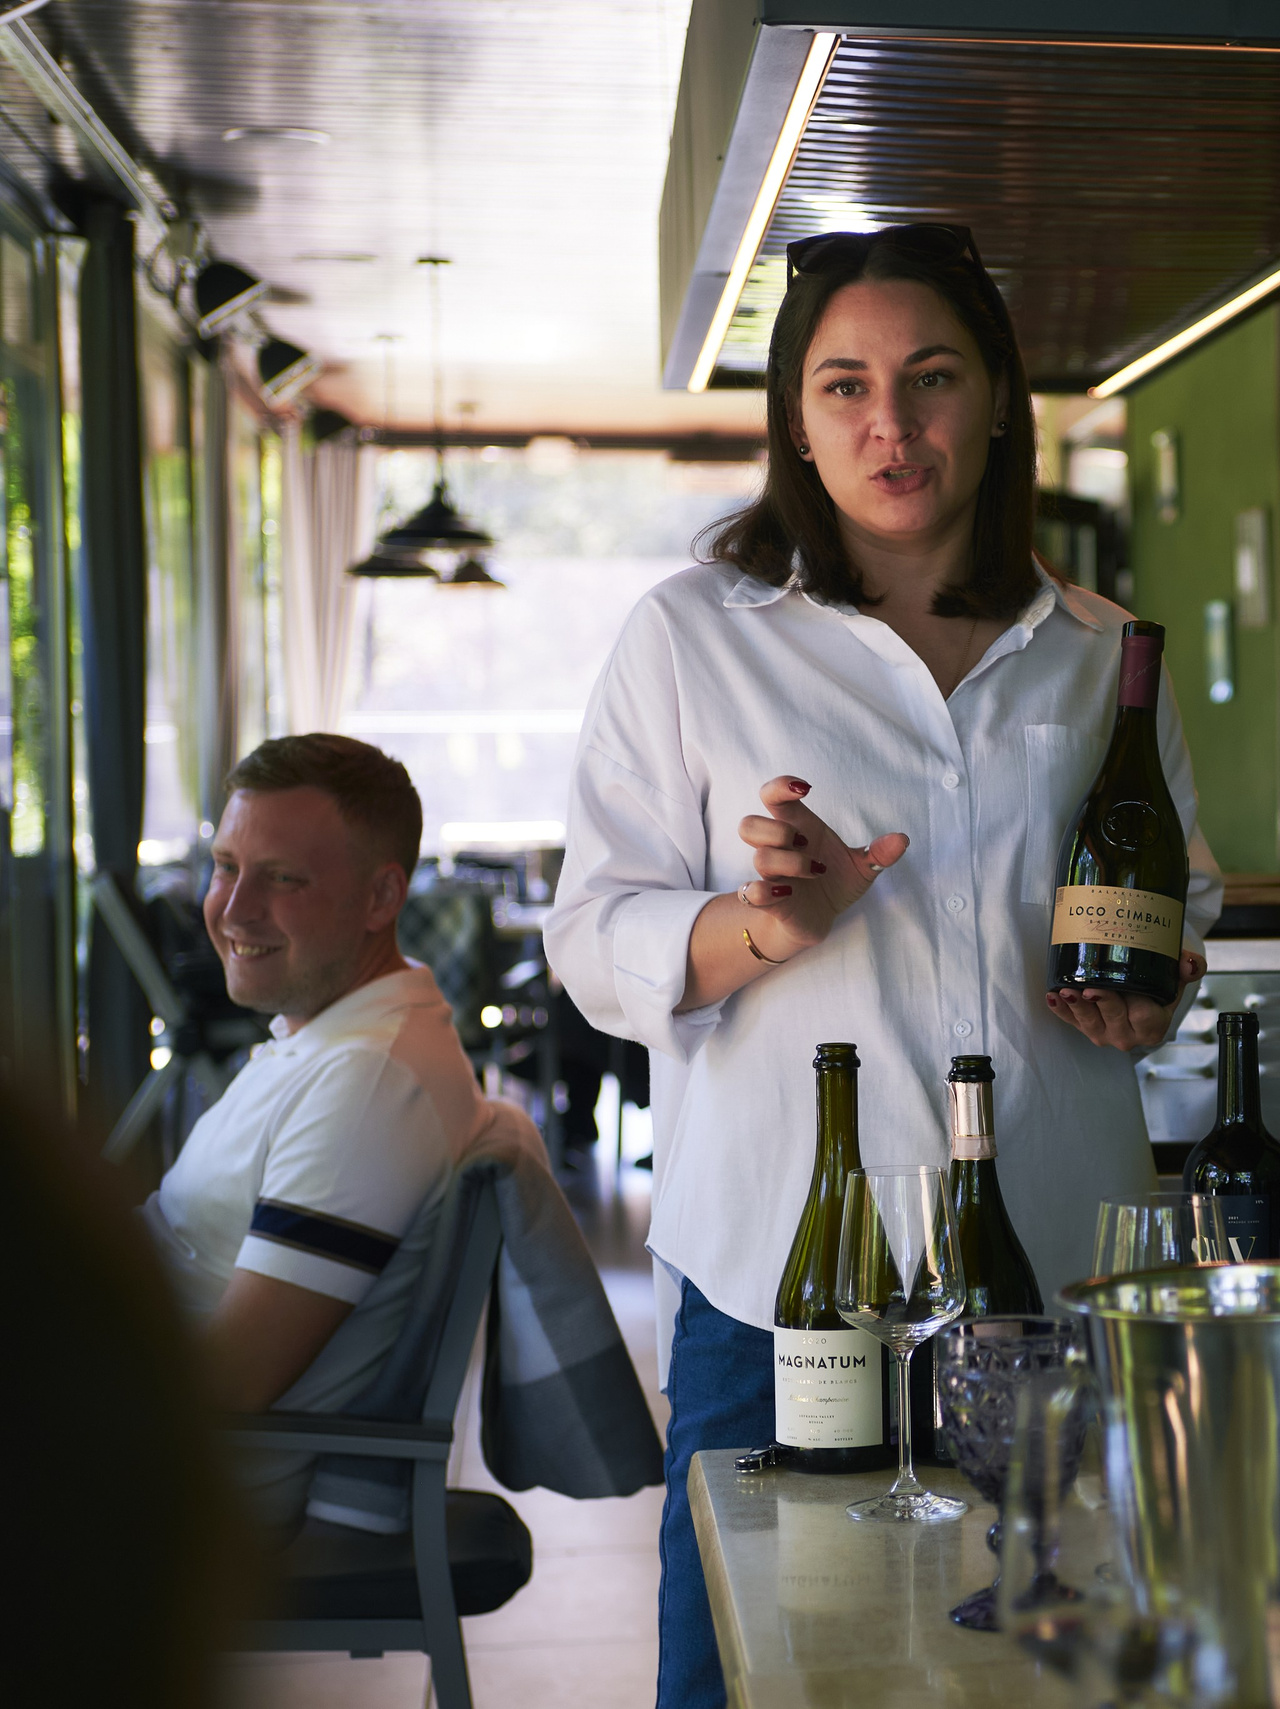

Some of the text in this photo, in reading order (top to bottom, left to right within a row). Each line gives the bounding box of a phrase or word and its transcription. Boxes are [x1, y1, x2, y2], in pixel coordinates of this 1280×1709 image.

[1091, 889, 1154, 900] BALAKLAVA
[1069, 906, 1106, 917] LOCO
[1115, 908, 1171, 929] CIMBALI
[1104, 932, 1135, 940] REPIN
[802, 1337, 827, 1345] 2020
[778, 1354, 866, 1369] MAGNATUM
